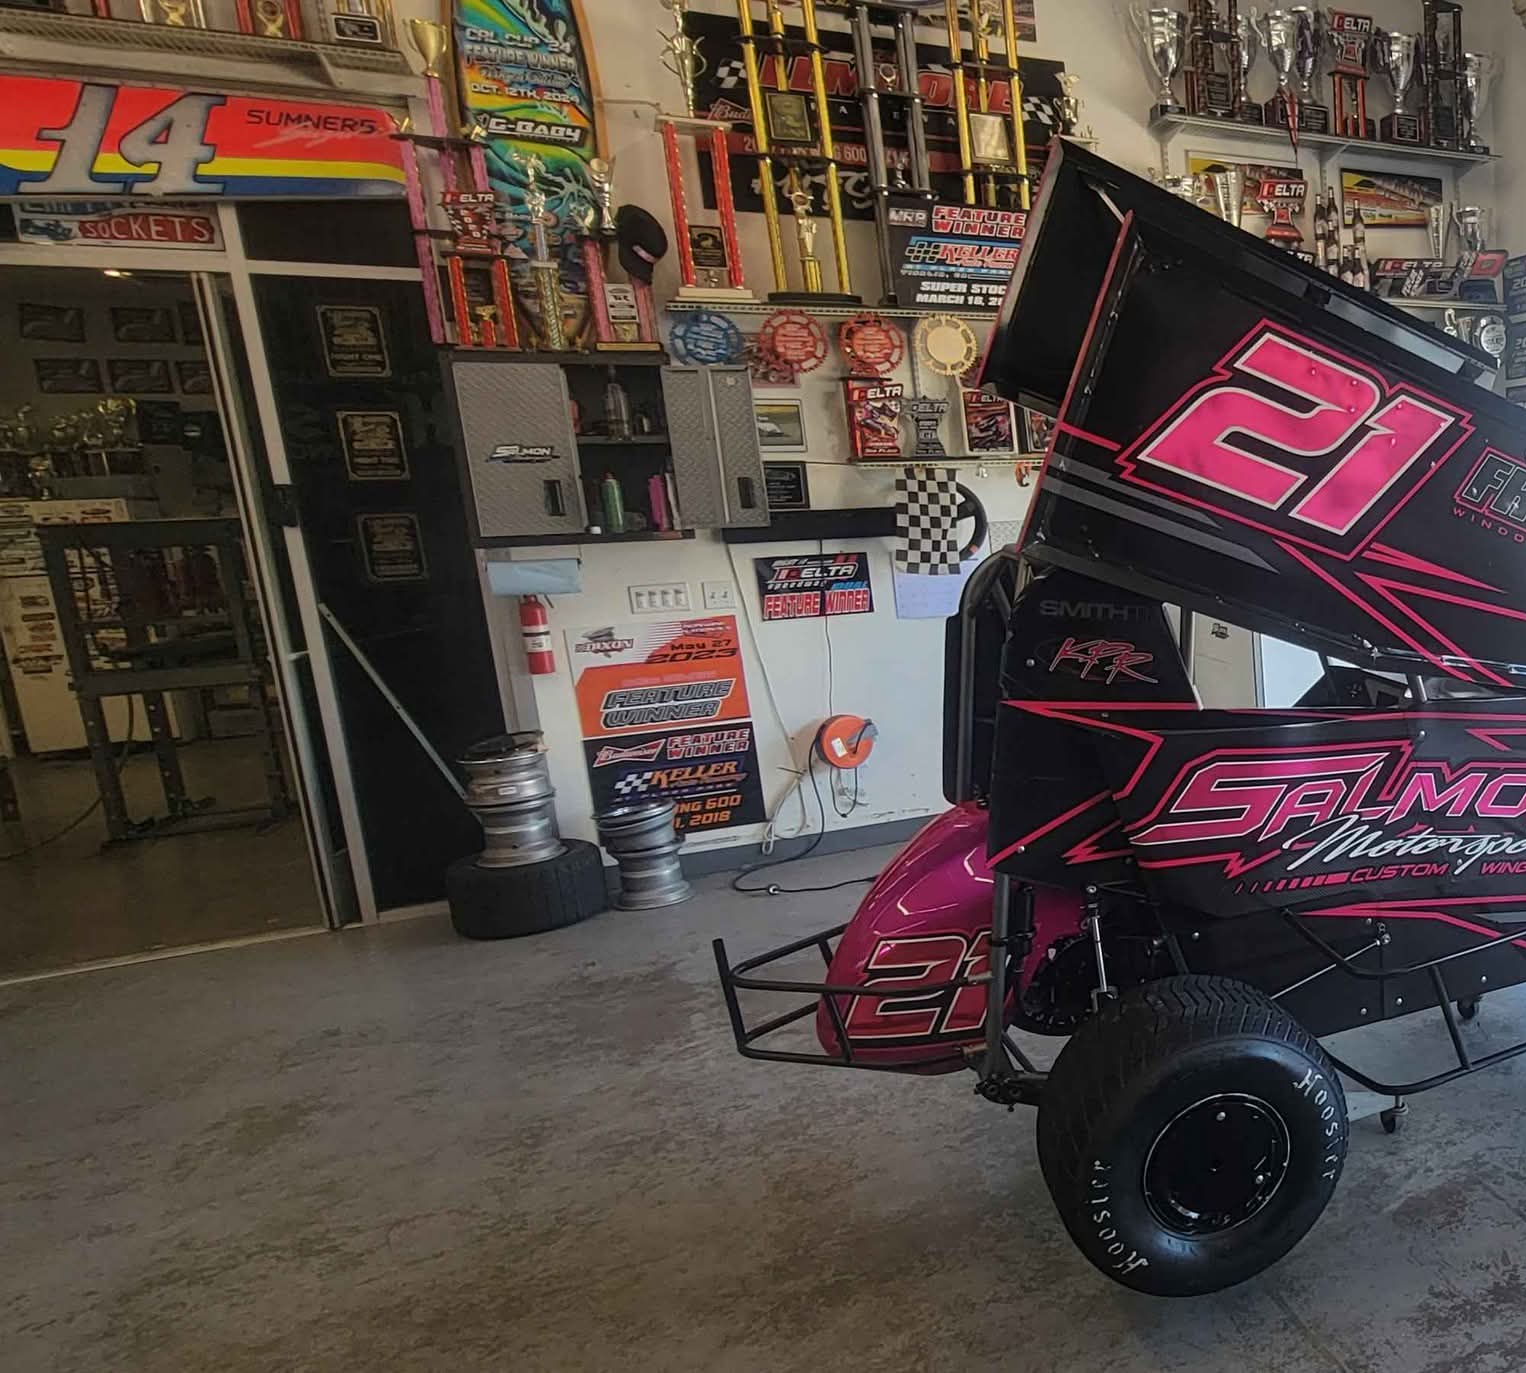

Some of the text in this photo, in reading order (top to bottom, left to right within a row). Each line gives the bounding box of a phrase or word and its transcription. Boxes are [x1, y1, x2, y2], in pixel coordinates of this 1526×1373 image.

[17, 84, 230, 196] 14
[932, 205, 1027, 225] FEATURE
[932, 219, 1026, 239] WINNER
[940, 242, 1020, 264] KELLER
[920, 281, 1008, 295] SUPER STOC
[915, 293, 965, 305] MARCH
[1138, 332, 1457, 537] 21
[763, 588, 871, 620] FEATURE WINNER
[645, 648, 738, 664] 2023
[1048, 637, 1159, 685] KPR
[603, 679, 735, 710] FEATURE
[603, 700, 721, 728] WINNER
[667, 728, 751, 750] FEATURE
[667, 740, 750, 761] WINNER
[650, 760, 739, 789] KELLER
[672, 801, 703, 815] ING
[704, 794, 742, 810] 600
[689, 810, 732, 827] 2018
[1350, 862, 1450, 883] CUSTOM
